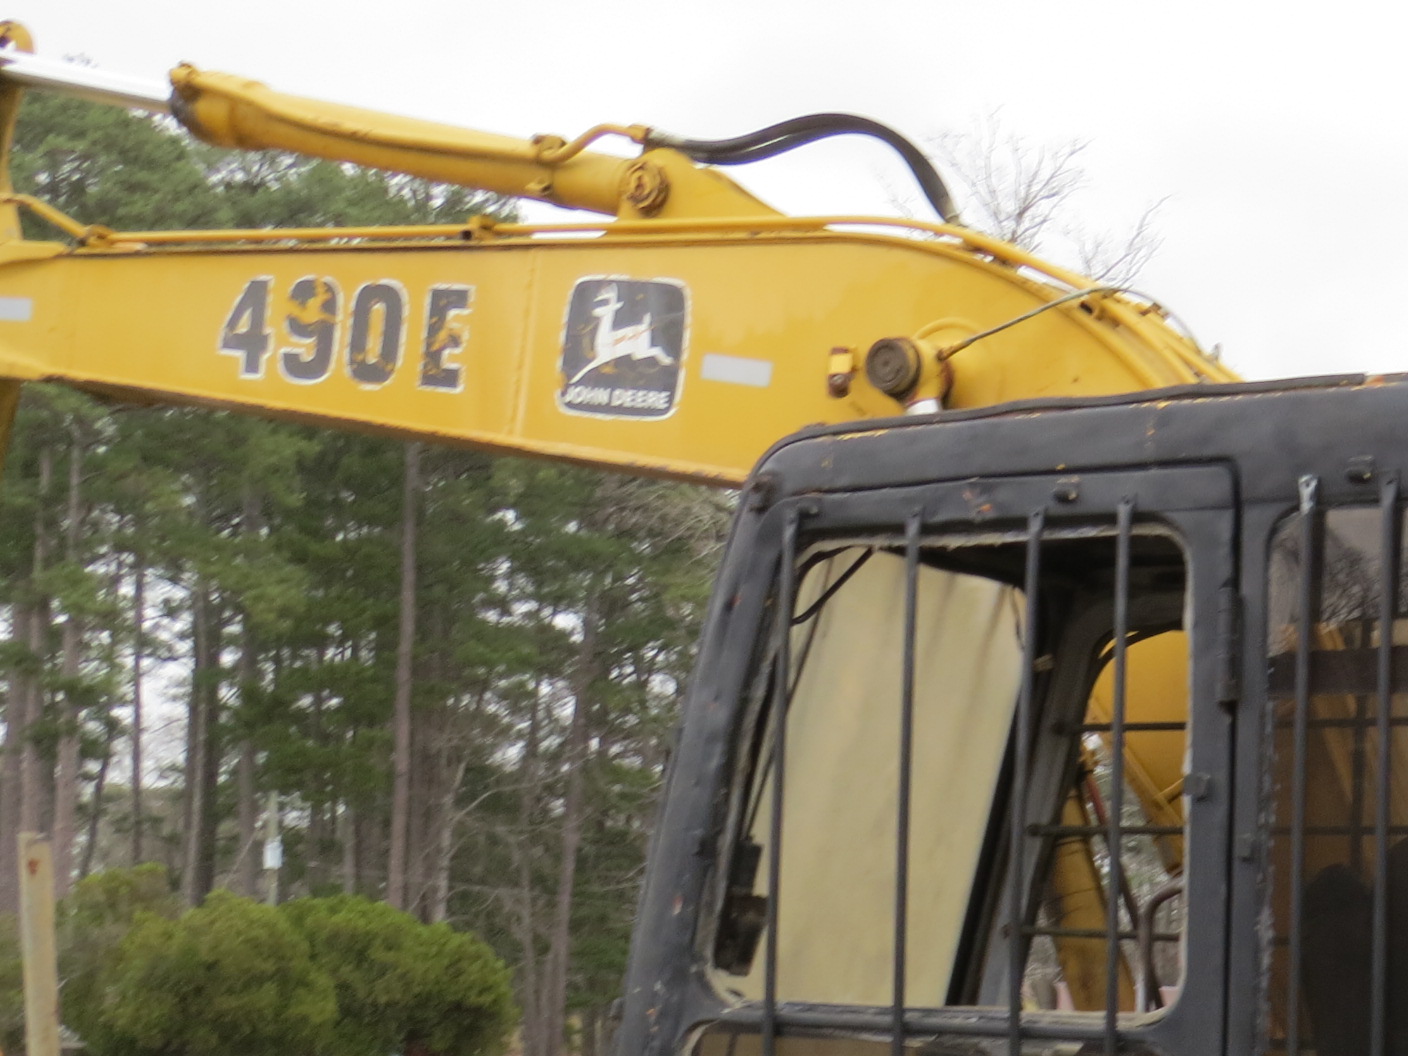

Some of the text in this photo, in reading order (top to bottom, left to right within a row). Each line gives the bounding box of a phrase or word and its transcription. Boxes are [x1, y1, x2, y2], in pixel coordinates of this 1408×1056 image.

[218, 275, 476, 393] 490E
[561, 385, 671, 410] JOHN DEERE
